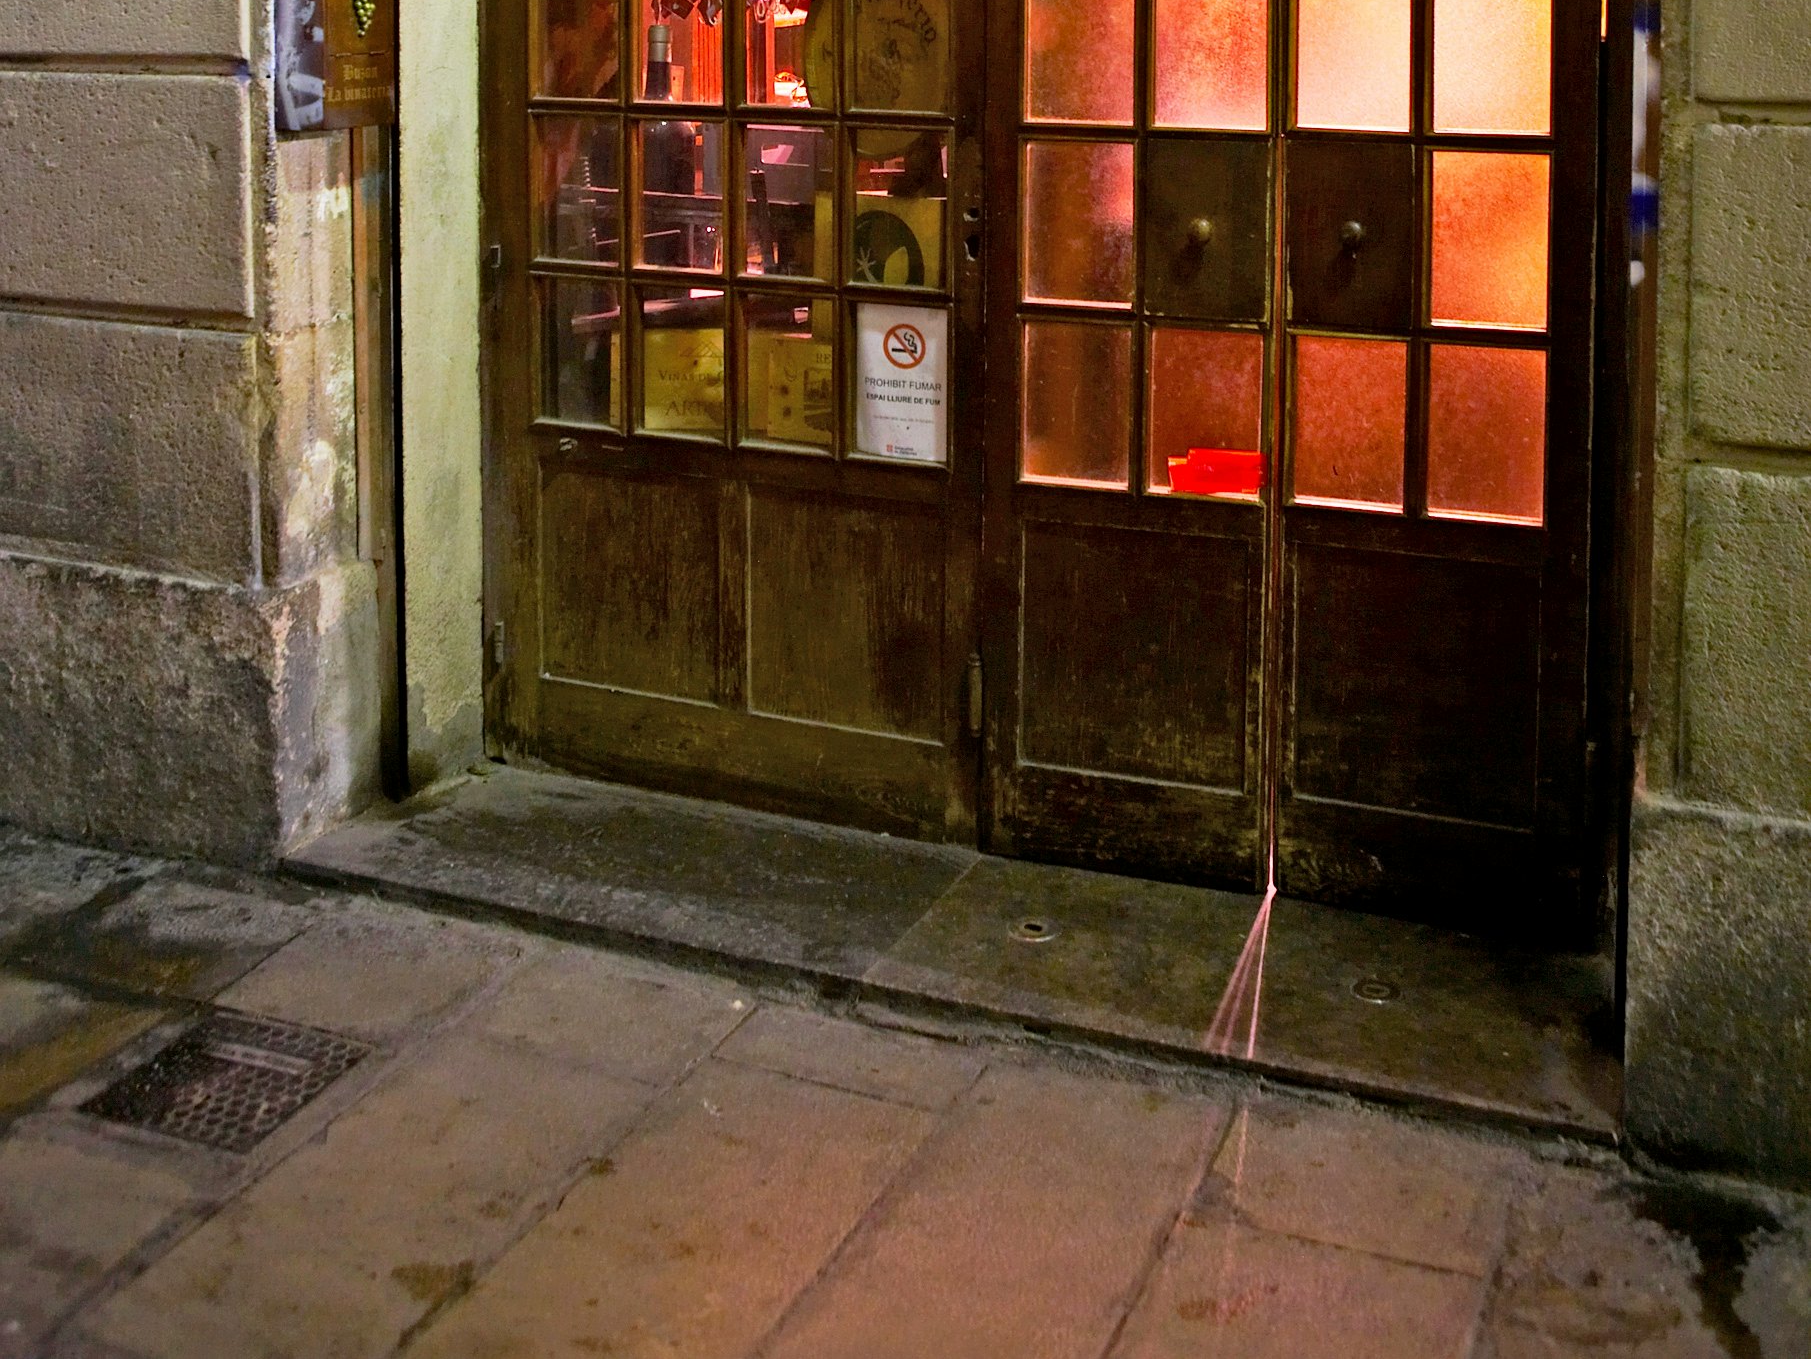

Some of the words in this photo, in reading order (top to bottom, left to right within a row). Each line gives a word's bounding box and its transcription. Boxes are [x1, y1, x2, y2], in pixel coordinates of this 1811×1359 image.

[864, 377, 907, 389] PROHIBIT
[909, 380, 942, 392] FUMAR
[866, 392, 886, 401] ESPAI
[887, 395, 912, 403] LLIURE
[925, 398, 941, 406] FUM
